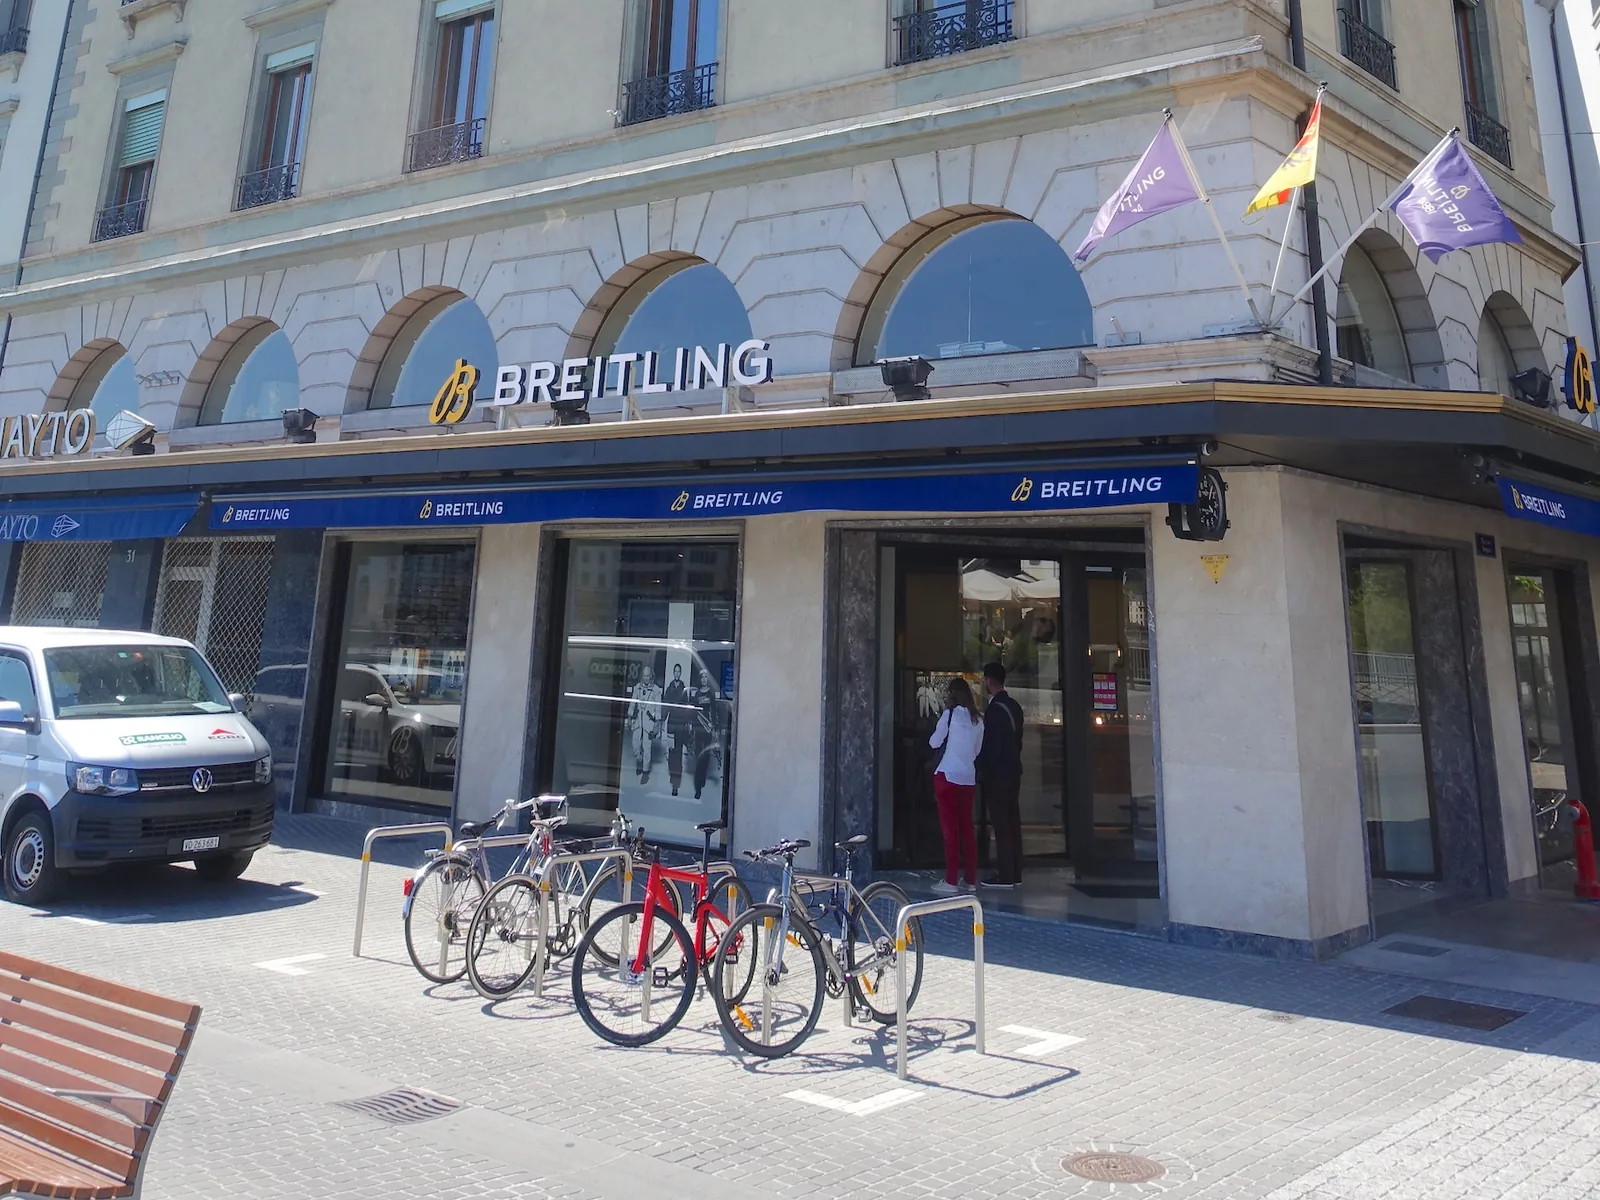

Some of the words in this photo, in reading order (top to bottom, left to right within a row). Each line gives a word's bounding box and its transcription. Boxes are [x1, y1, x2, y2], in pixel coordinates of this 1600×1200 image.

[494, 338, 773, 406] BREITLING
[0, 408, 97, 460] AYTO
[1041, 476, 1162, 498] BREITLING
[435, 501, 504, 517] BREITLING
[693, 491, 783, 509] BREITLING
[1521, 493, 1566, 519] BREITLING
[235, 508, 290, 521] BREITLING
[0, 514, 39, 540] AYTO
[125, 549, 136, 563] 31
